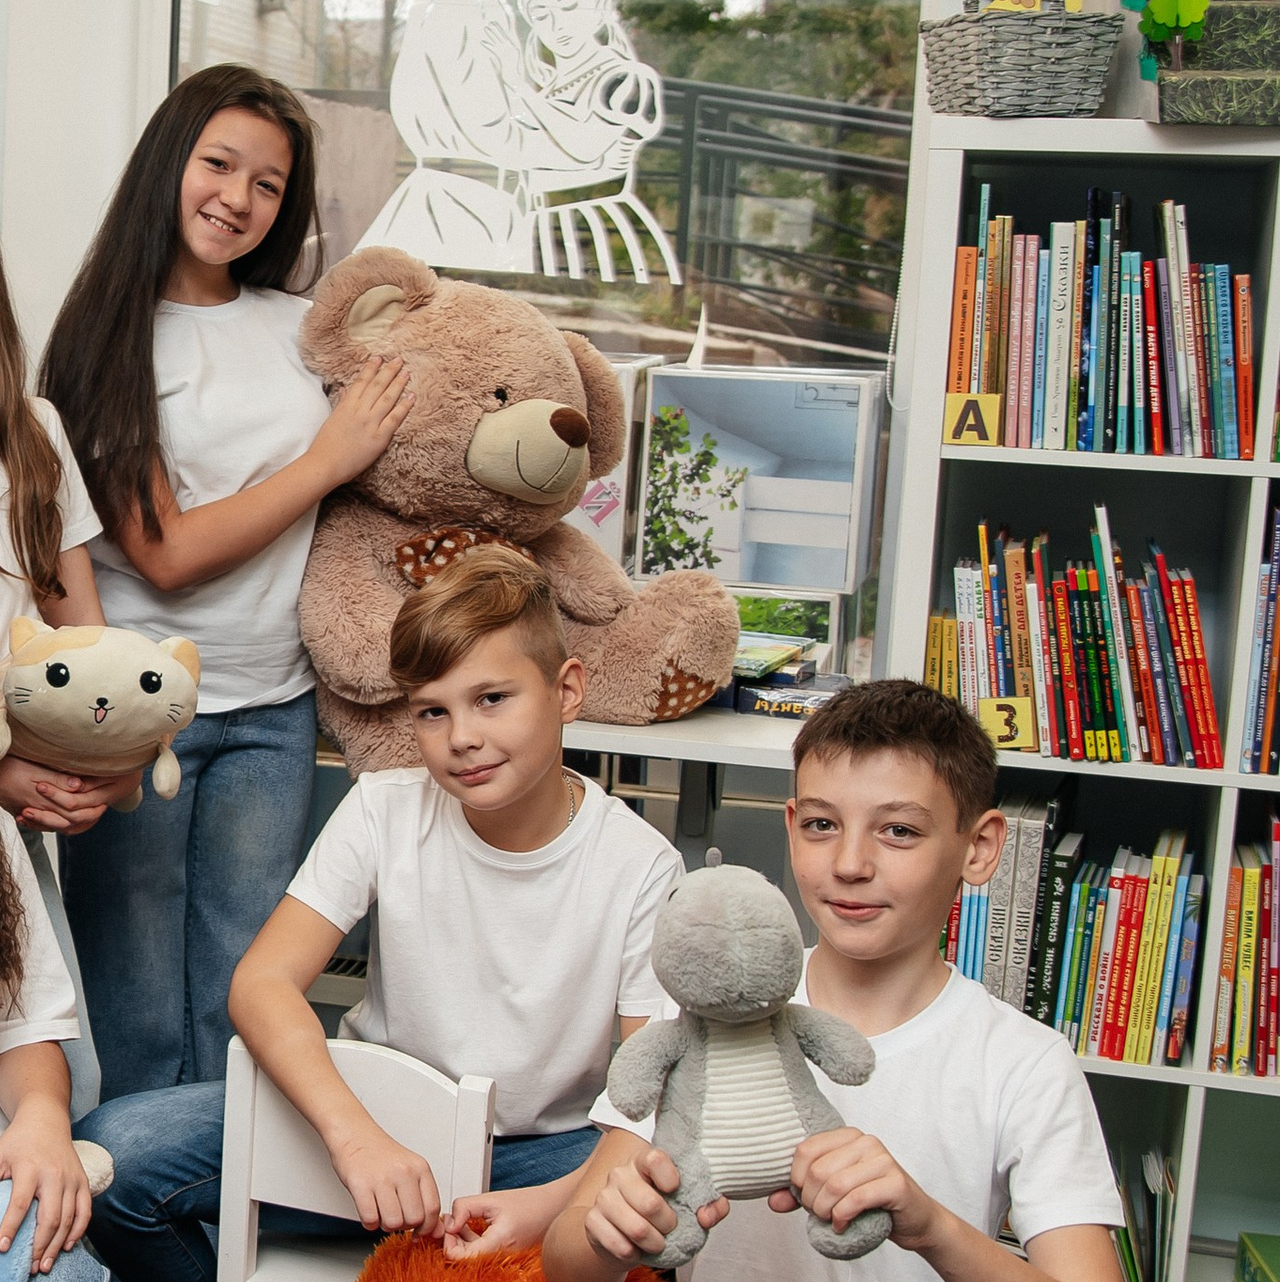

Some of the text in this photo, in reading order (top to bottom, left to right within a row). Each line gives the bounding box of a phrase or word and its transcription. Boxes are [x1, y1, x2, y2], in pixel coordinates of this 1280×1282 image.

[986, 257, 995, 286] СКАЗКИ
[1075, 260, 1083, 279] САДУ
[1147, 332, 1156, 359] РАСТУ.
[1036, 355, 1044, 390] Королева
[1148, 360, 1157, 385] СТИХИ
[1150, 386, 1158, 413] ДЕТЯМ
[951, 399, 990, 441] А
[974, 580, 984, 619] БЕМБИ
[1013, 572, 1025, 631] ДЛЯ ДЕТЕЙ
[1171, 585, 1182, 603] КРАЙ
[1183, 584, 1194, 603] КРАЙ
[1056, 597, 1067, 620] ИСТОРИЯ
[1188, 614, 1199, 630] МОЙ
[1265, 601, 1275, 641] ПРИКЛЮЧЕНИЯ
[958, 620, 966, 644] СПЯЩАЯ
[967, 621, 975, 645] СПЯЩАЯ
[1176, 615, 1187, 631] МОЙ
[959, 645, 967, 671] ЦАРЕВНА
[1016, 633, 1025, 668] Избранные
[1115, 639, 1125, 660] СКАЗКИ
[1179, 632, 1192, 659] РОДНОЙ
[1191, 631, 1203, 658] РОДНОЙ
[968, 646, 976, 672] ЦАРЕВНА
[1061, 652, 1072, 675] СТРАШНО
[1047, 901, 1061, 942] СКАЗКИ
[1225, 909, 1237, 937] ВИЛЛА
[989, 909, 1006, 962] СКАЗКИ
[1013, 911, 1030, 965] СКАЗКИ
[1114, 925, 1126, 959] РАССКАЗЫ
[1125, 929, 1138, 962] РАССКАЗЫ
[1241, 909, 1255, 970] ВИЛЛА ЧУДЕС
[1098, 951, 1110, 981] ВОЙНЕ
[1222, 940, 1234, 969] ЧУДЕС
[1110, 965, 1121, 987] СТИХИ
[1122, 969, 1132, 991] СТИХИ
[1130, 941, 1151, 1029] Приключения ЧИПОЛЛИНО
[1142, 942, 1164, 1031] Приключения ЧИПОЛЛИНО
[1108, 988, 1118, 1001] ПРО
[1120, 991, 1129, 1004] ПРО
[1105, 1002, 1116, 1024] ДЕТЕЙ
[1117, 1005, 1127, 1027] ДЕТЕЙ
